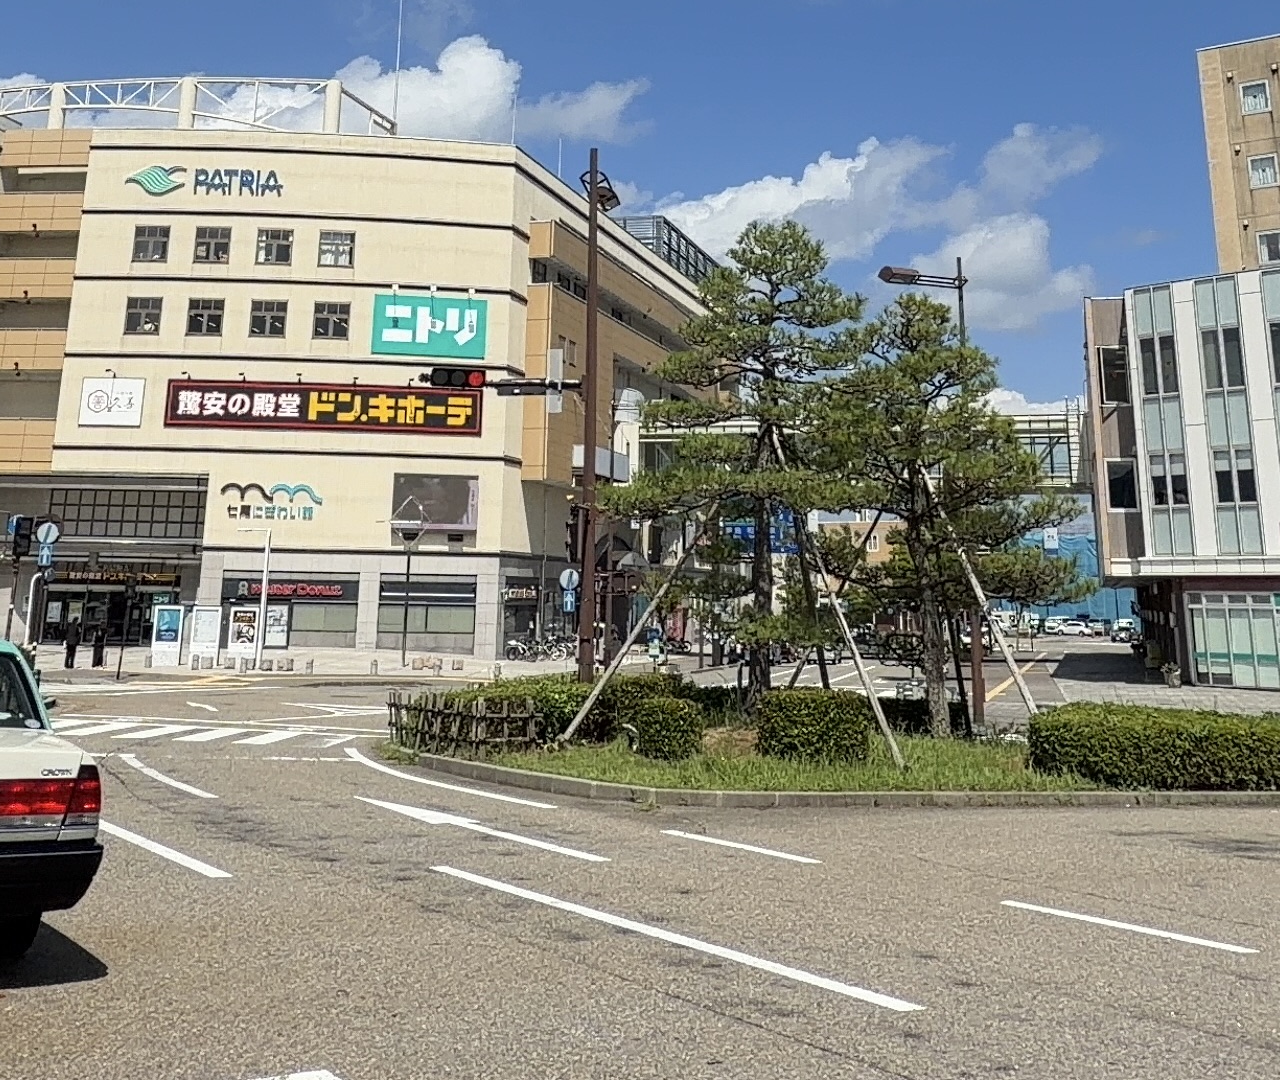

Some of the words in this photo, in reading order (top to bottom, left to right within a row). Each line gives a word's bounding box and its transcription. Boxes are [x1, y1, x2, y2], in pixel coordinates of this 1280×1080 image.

[193, 168, 284, 197] PATRIA
[381, 304, 478, 346] ニトリ
[177, 390, 301, 418] 驚安の殿堂
